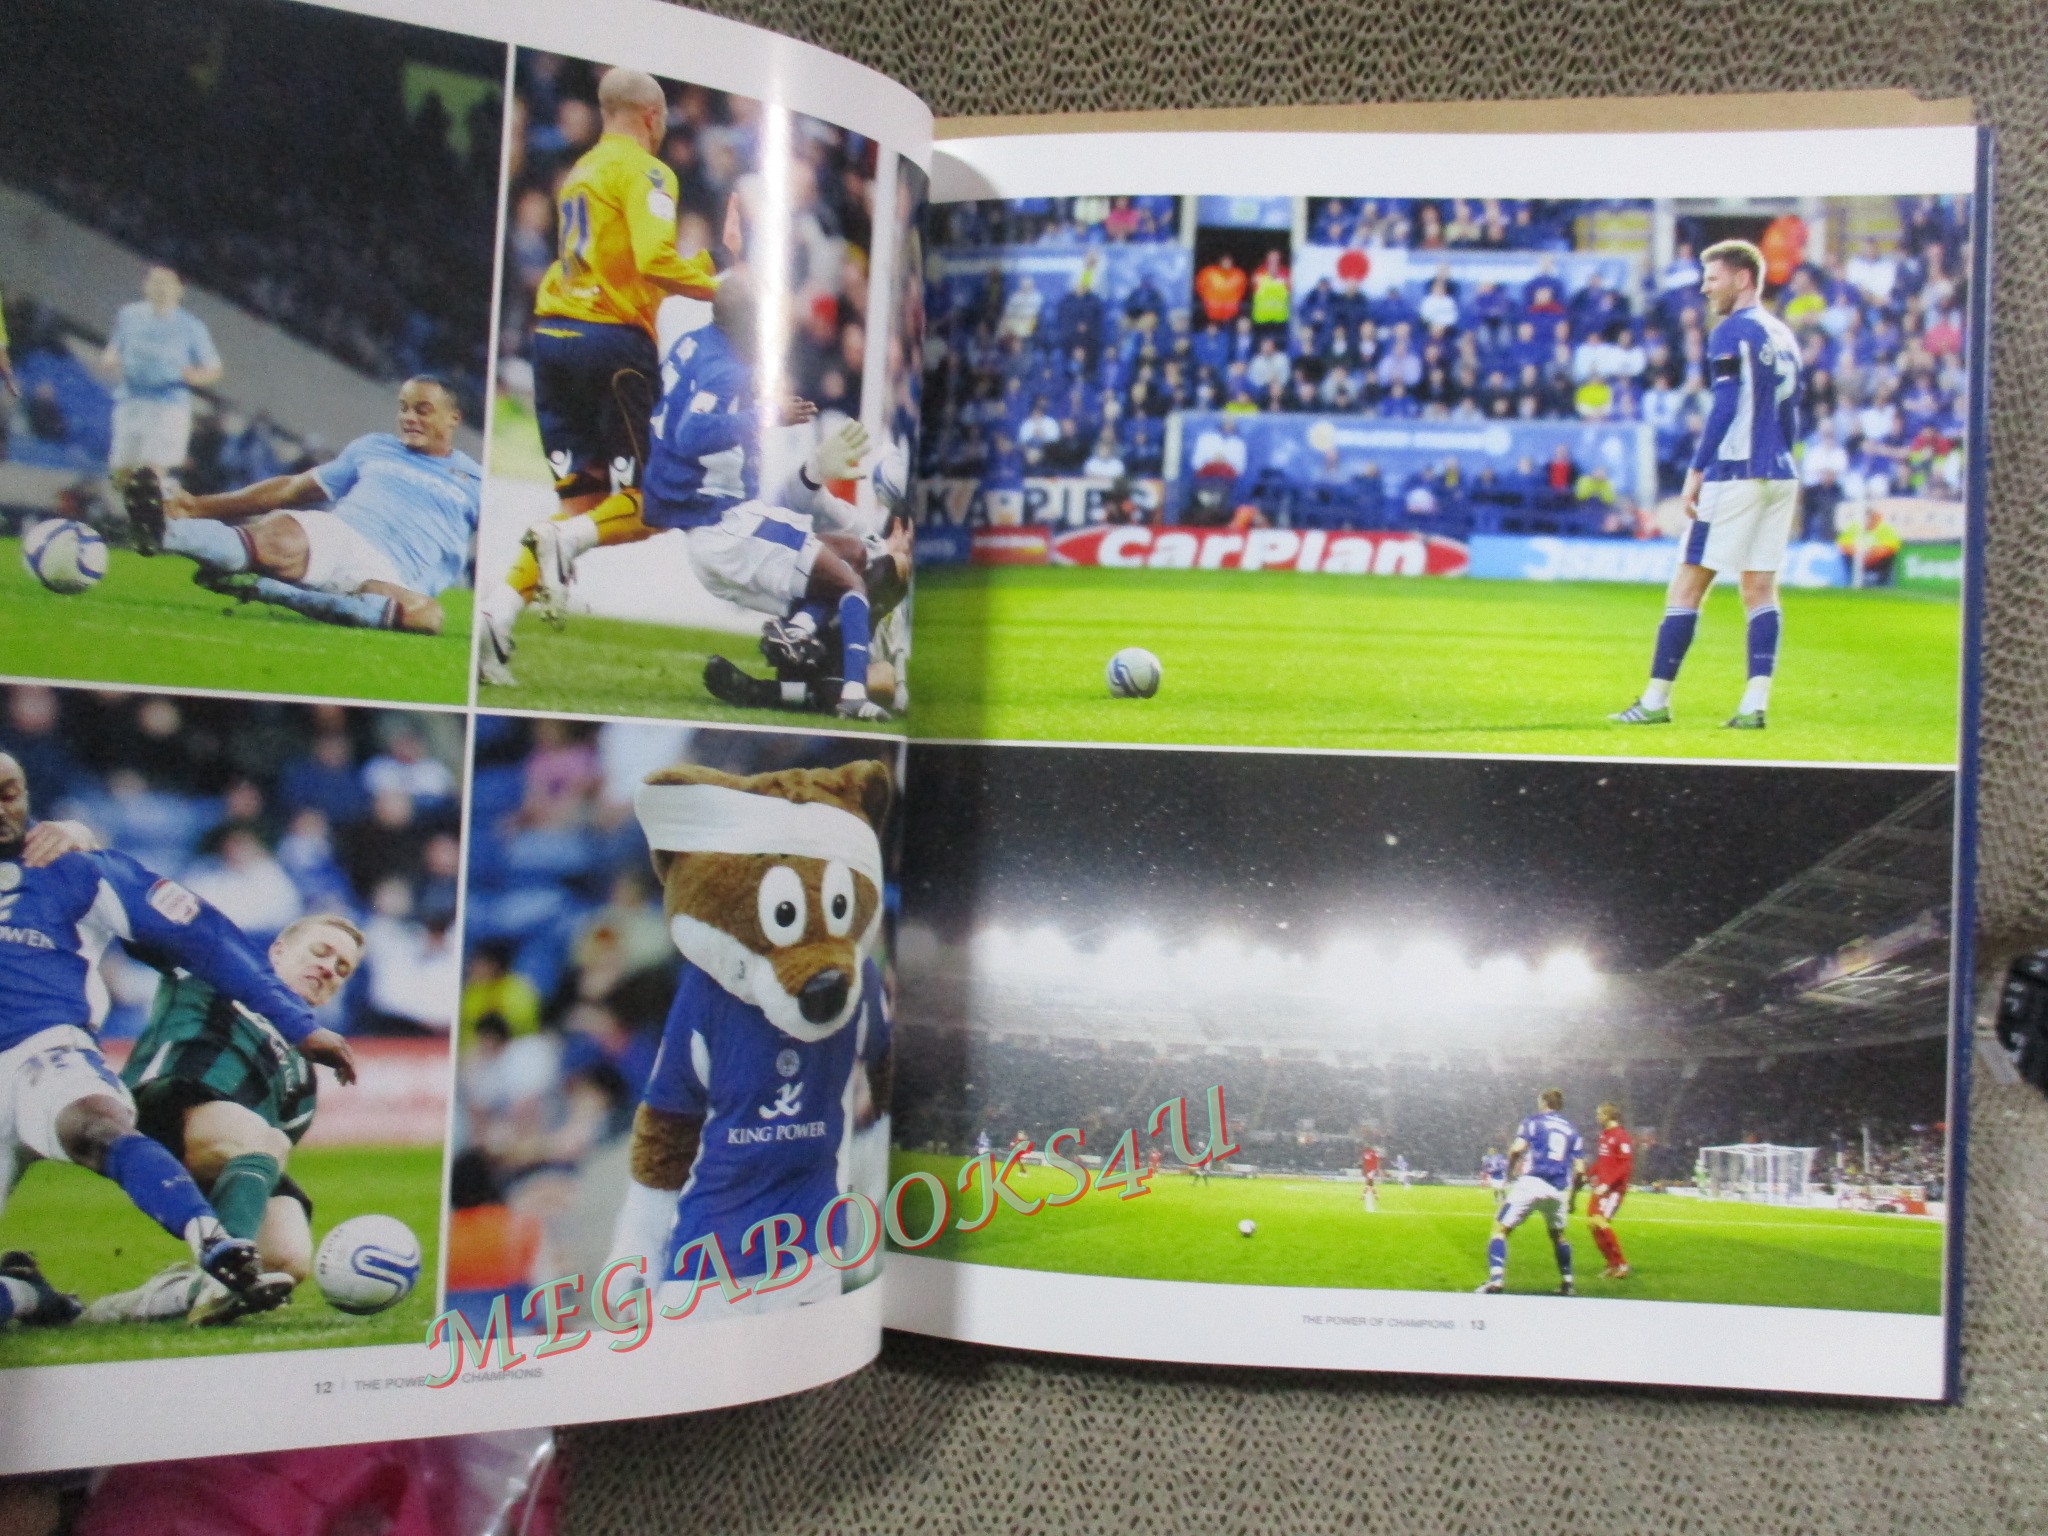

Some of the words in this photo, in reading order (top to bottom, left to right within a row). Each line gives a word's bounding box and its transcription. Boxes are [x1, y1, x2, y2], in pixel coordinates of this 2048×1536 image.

[728, 1126, 772, 1144] KING
[776, 1121, 827, 1140] POWER
[1547, 1132, 1567, 1161] 9
[1303, 1314, 1323, 1325] THE
[1325, 1316, 1367, 1326] POWER
[1369, 1317, 1384, 1327] OF
[1387, 1318, 1455, 1330] CHAMPIONS
[1470, 1319, 1486, 1330] 13
[314, 1381, 333, 1394] 12
[355, 1379, 380, 1390] THE
[385, 1375, 432, 1389] POWE
[461, 1367, 543, 1383] CHAMPIONS
